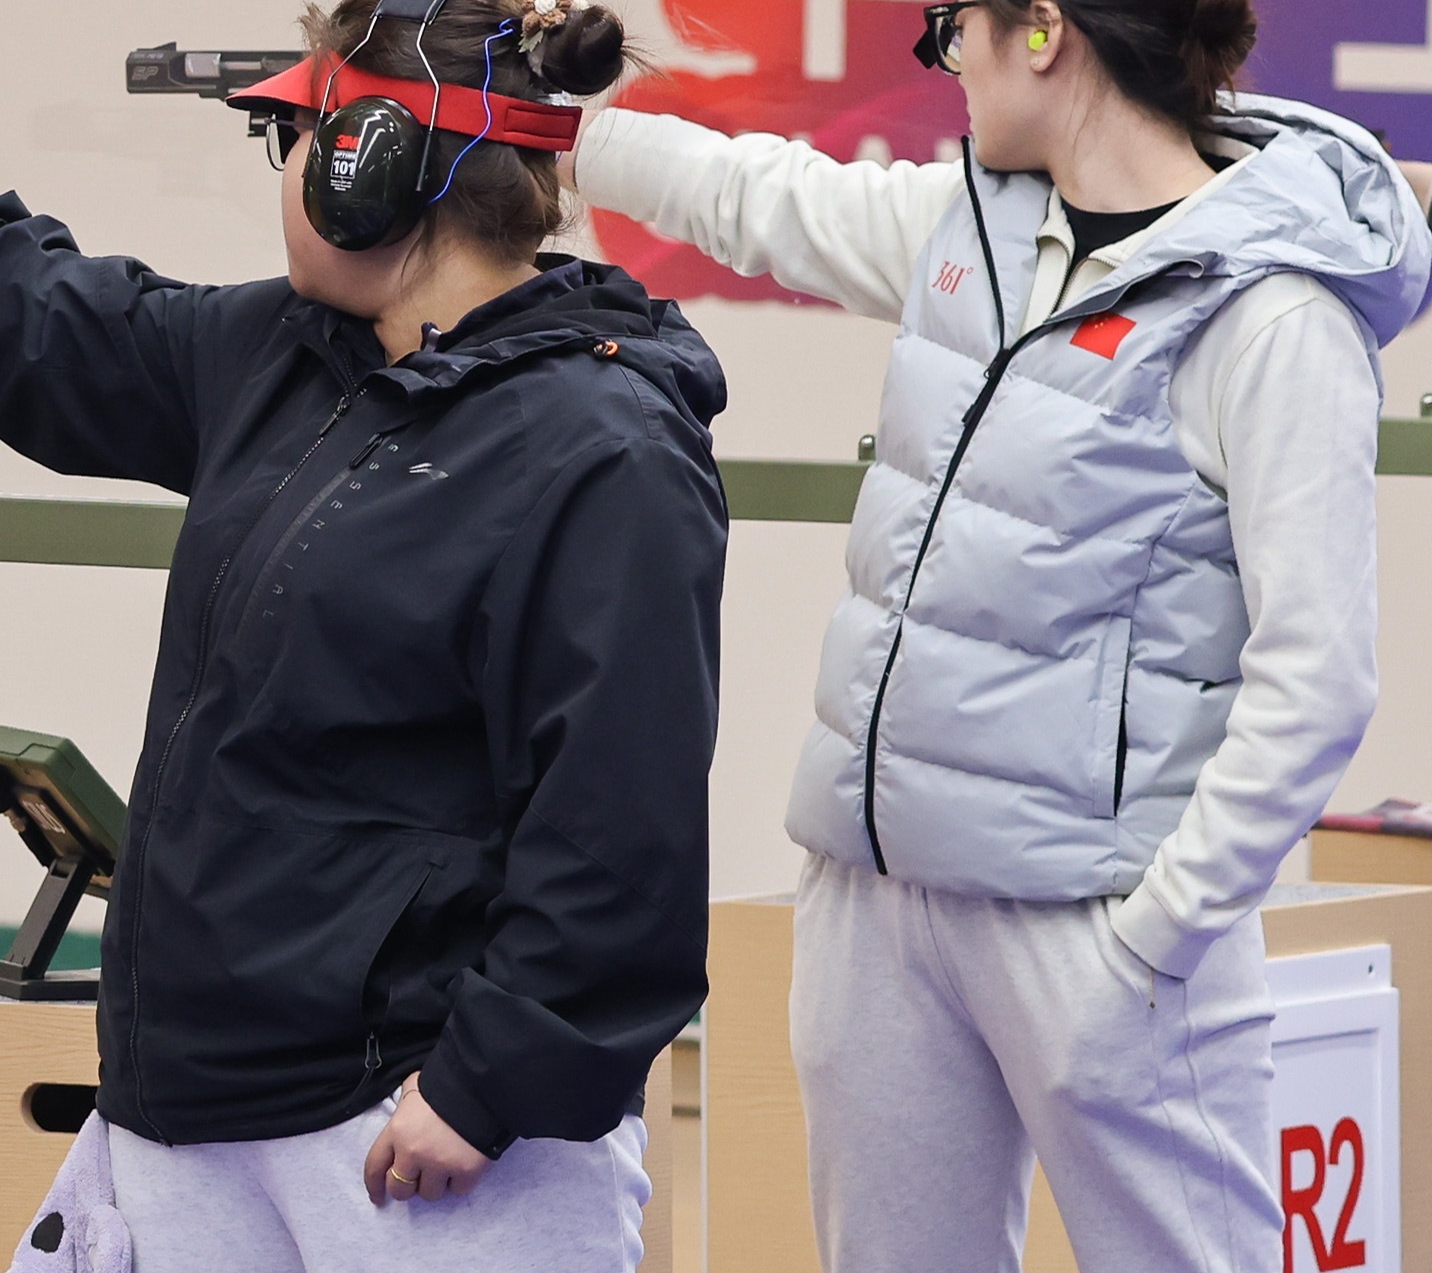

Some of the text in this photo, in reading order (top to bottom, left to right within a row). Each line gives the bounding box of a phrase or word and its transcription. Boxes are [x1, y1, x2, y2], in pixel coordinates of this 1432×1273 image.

[336, 134, 360, 150] 3M
[333, 160, 355, 176] 101
[263, 443, 399, 618] ESSENTIAL
